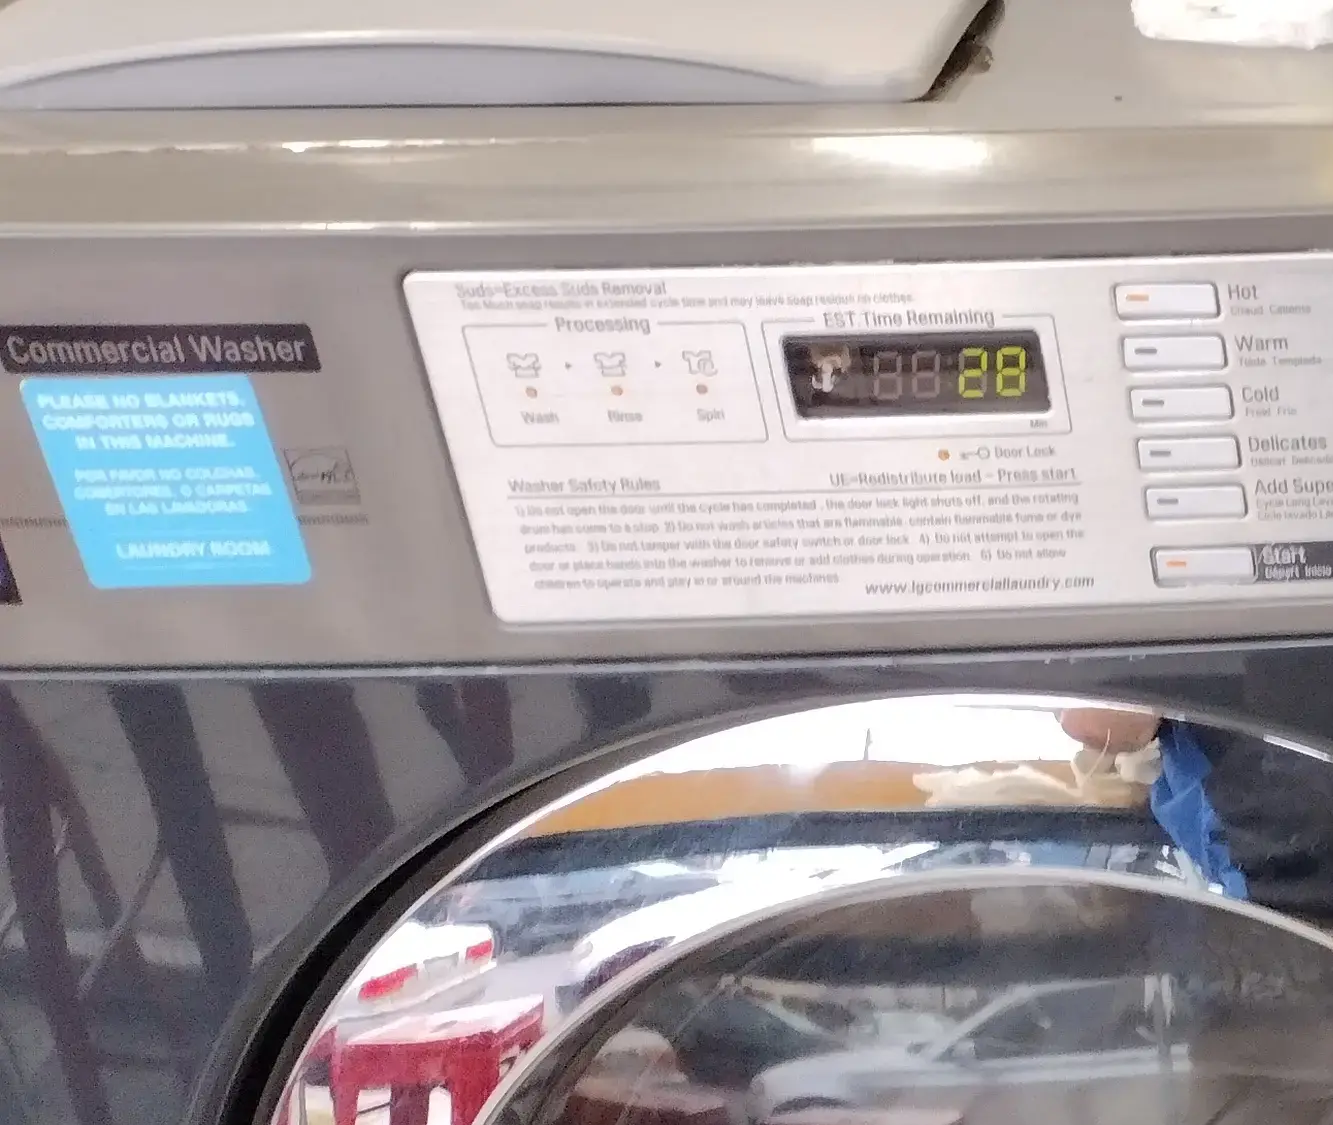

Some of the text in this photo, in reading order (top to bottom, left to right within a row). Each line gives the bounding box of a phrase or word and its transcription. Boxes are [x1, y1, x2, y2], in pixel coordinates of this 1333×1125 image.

[601, 282, 666, 296] Removal
[1228, 284, 1258, 300] Hot
[555, 317, 651, 334] Processing
[823, 309, 995, 328] EST Time Remaining
[7, 335, 306, 364] Commercial Washer
[1235, 334, 1288, 352] Warm
[959, 346, 1026, 399] 28
[38, 394, 108, 409] PLEASE
[113, 394, 139, 408] NO
[1242, 386, 1279, 403] Cold
[521, 411, 559, 424] Wash
[994, 445, 1055, 458] Door Lock
[1248, 435, 1327, 452] Delicates
[950, 470, 982, 484] load
[998, 468, 1037, 482] Press
[1043, 467, 1076, 480] start
[508, 478, 661, 494] Washer Safety Rules
[1254, 479, 1288, 495] Add
[116, 540, 270, 559] LAUNDRY ROOM
[1263, 545, 1306, 565] Start
